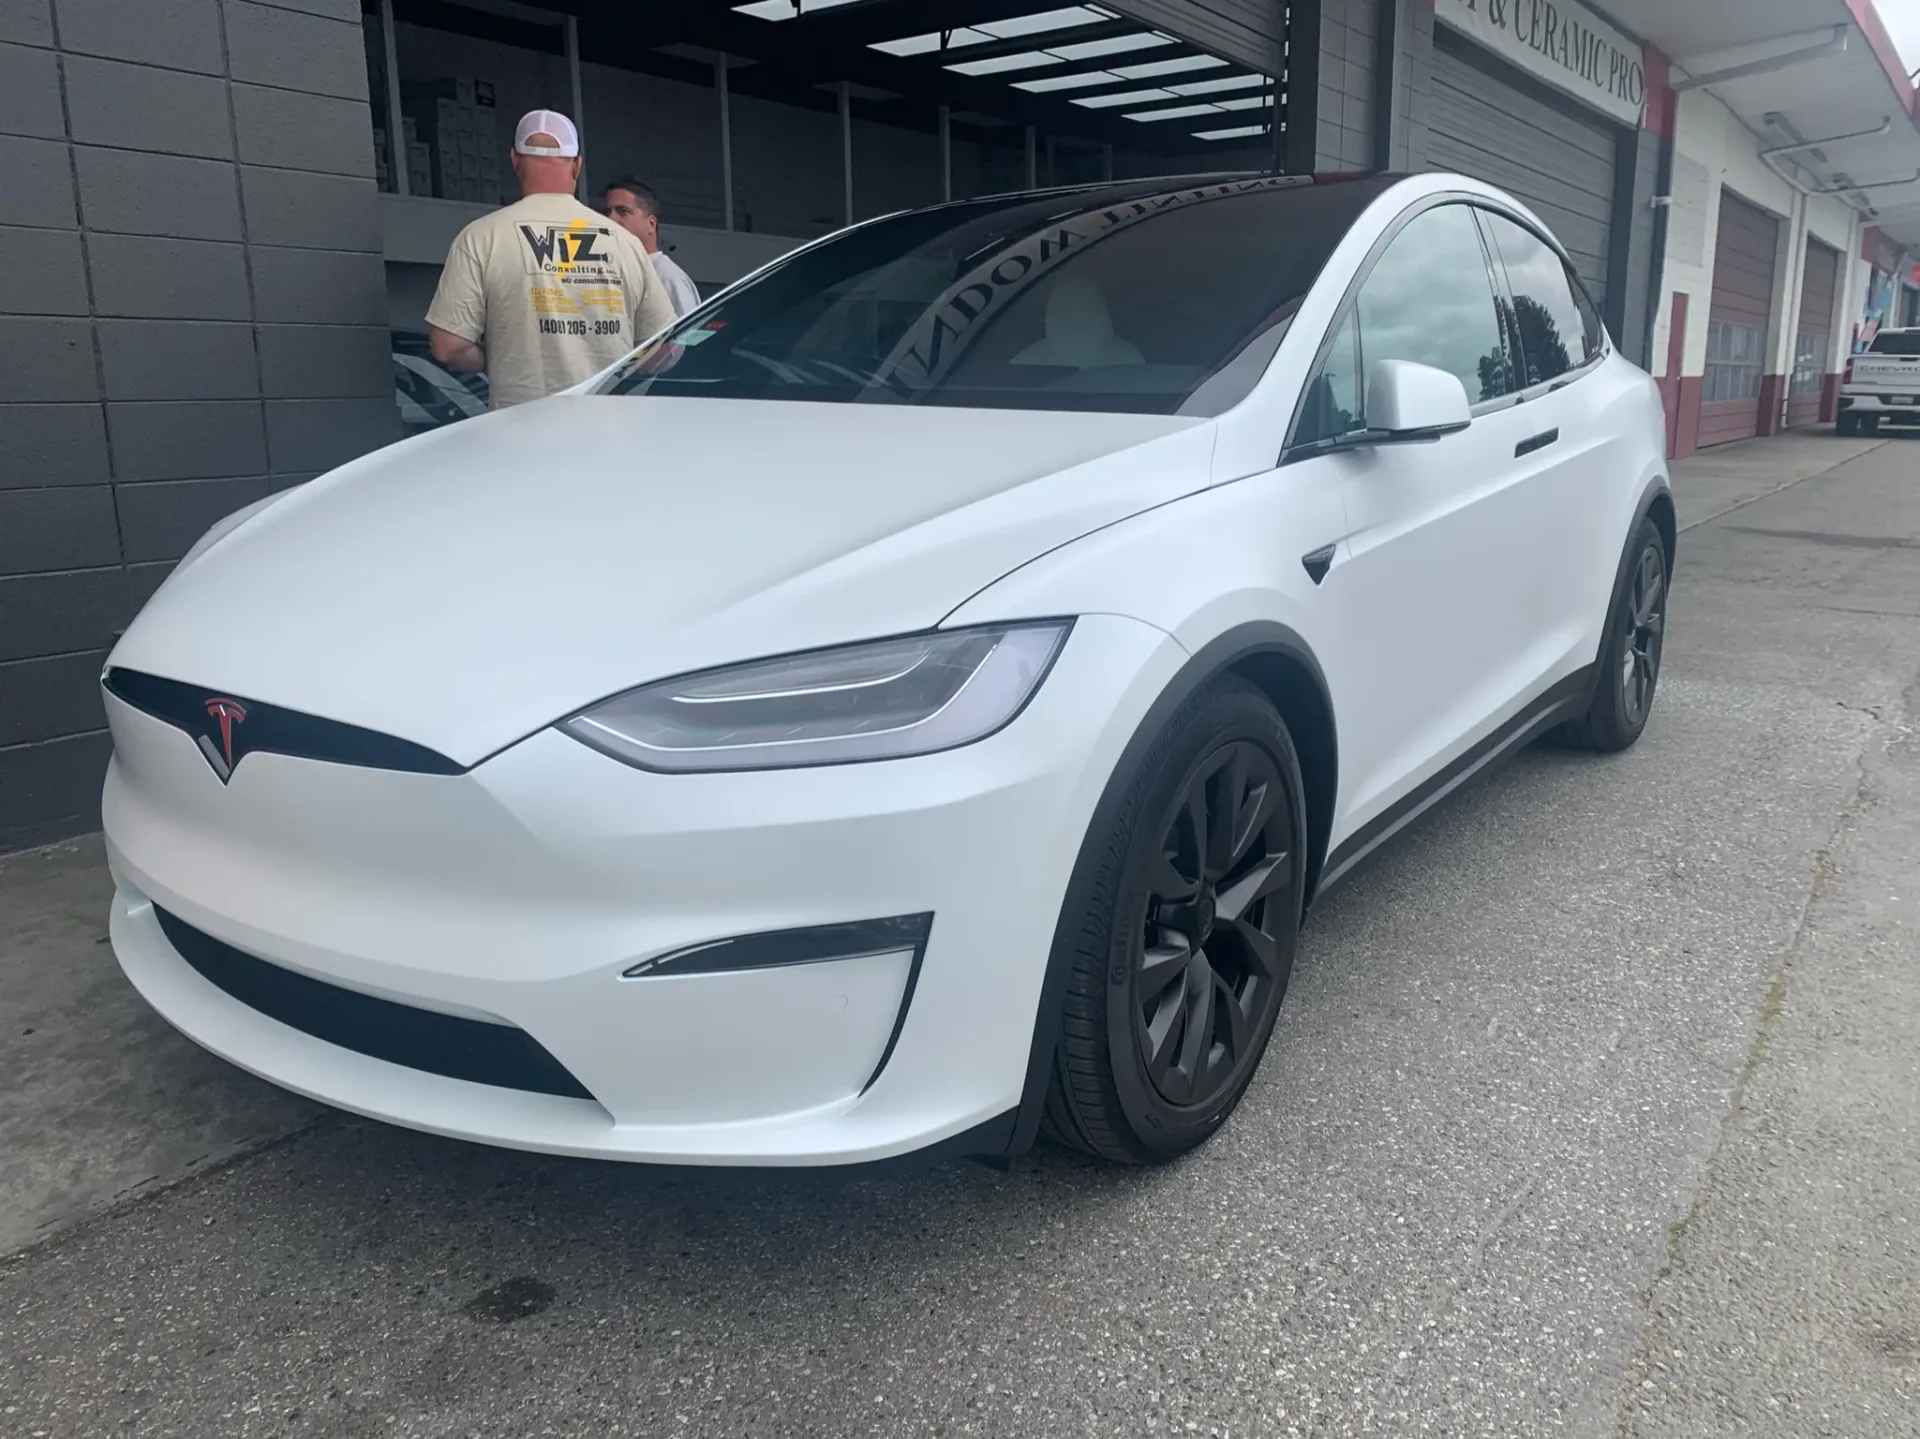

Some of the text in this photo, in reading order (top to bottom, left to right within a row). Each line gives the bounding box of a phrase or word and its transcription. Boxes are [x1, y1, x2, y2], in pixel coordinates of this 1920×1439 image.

[1514, 0, 1607, 88] CERAMIC
[1607, 49, 1644, 106] PRO
[544, 262, 603, 275] Consulting
[567, 320, 587, 335] 205
[594, 320, 621, 335] 3900
